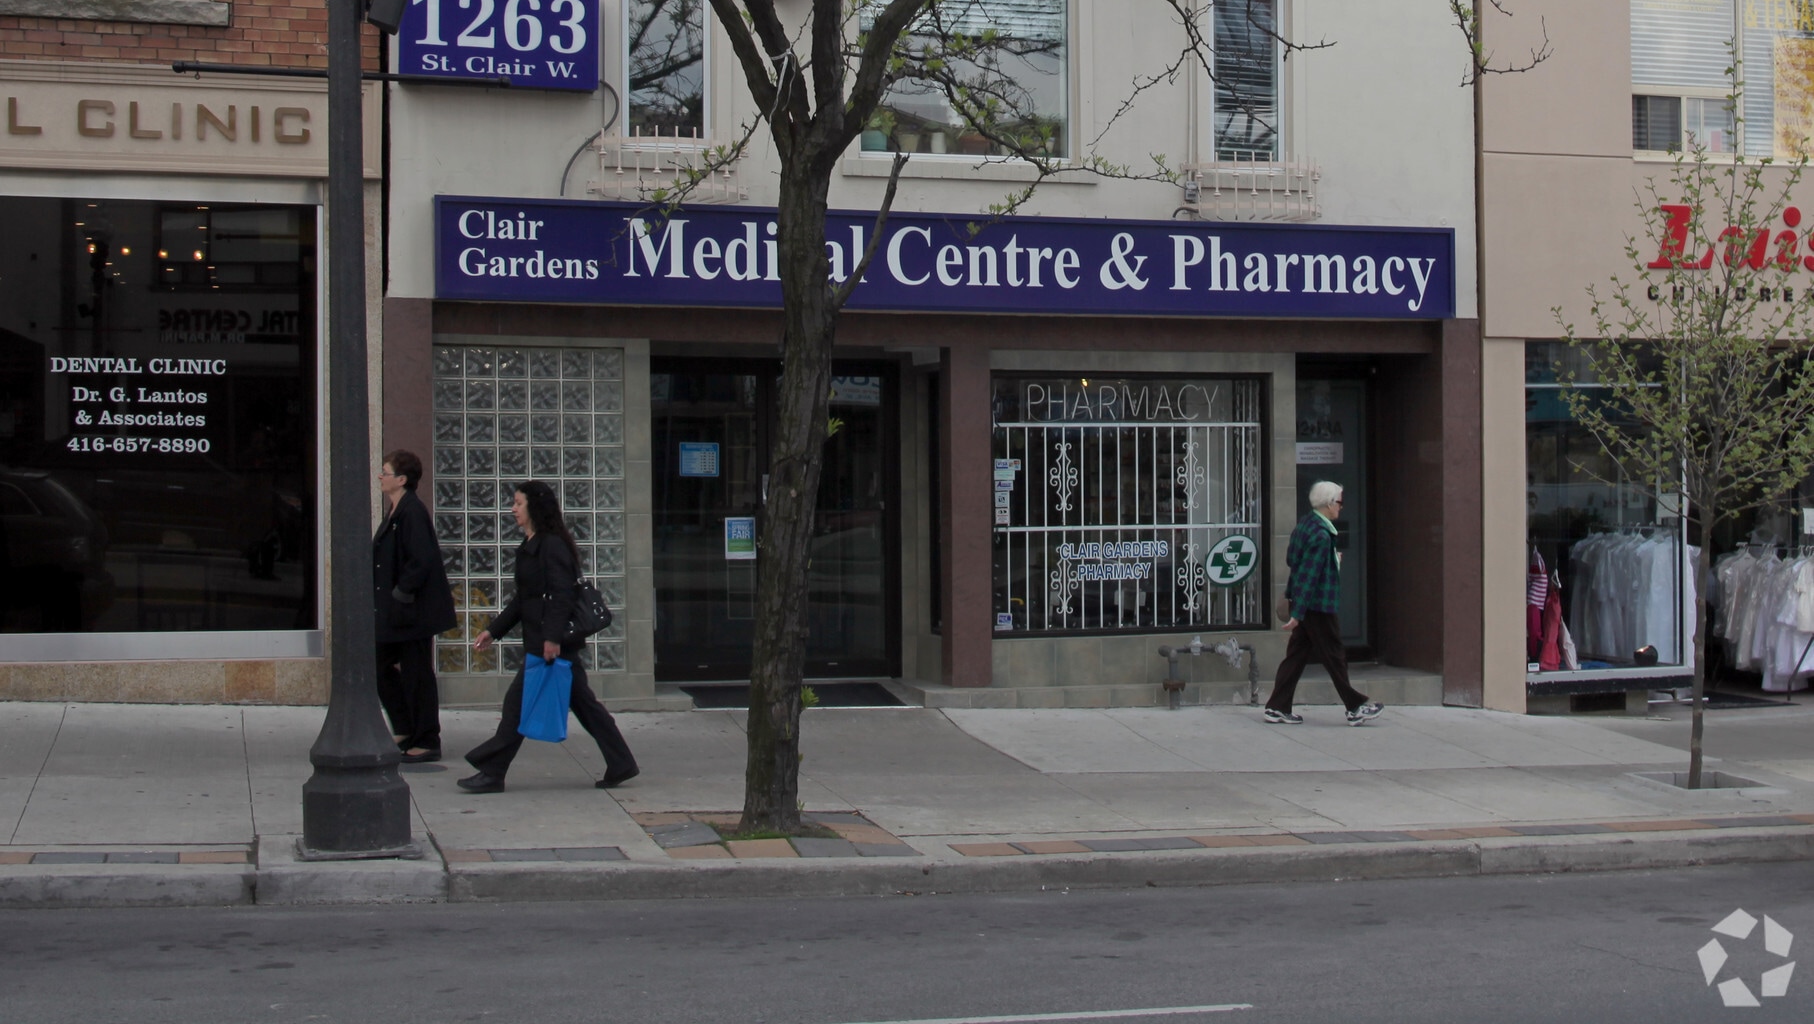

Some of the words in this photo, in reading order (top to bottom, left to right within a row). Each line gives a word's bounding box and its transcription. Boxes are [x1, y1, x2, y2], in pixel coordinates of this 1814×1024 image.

[421, 53, 457, 72] St.
[465, 56, 536, 76] Clair
[545, 61, 578, 79] W.
[8, 96, 42, 135] L
[77, 99, 311, 144] CLINIC
[458, 209, 544, 241] Clair
[458, 247, 600, 281] Gardens
[623, 217, 868, 283] Medial
[886, 226, 1081, 288] Centre
[1099, 232, 1149, 291] &
[1168, 234, 1436, 311] Pharmacy
[50, 357, 143, 374] DENTAL
[149, 358, 227, 375] CLINIC
[72, 386, 103, 402] Dr.
[109, 387, 131, 403] G.
[138, 387, 208, 404] Lantos
[1027, 383, 1219, 421] PHARMACY
[75, 409, 93, 426] &
[98, 410, 206, 427] Associates
[66, 437, 211, 453] 416-657-8890
[1060, 543, 1101, 560] CLAIR
[1103, 540, 1169, 559] GARDENS
[1077, 562, 1152, 581] PHARMACY
